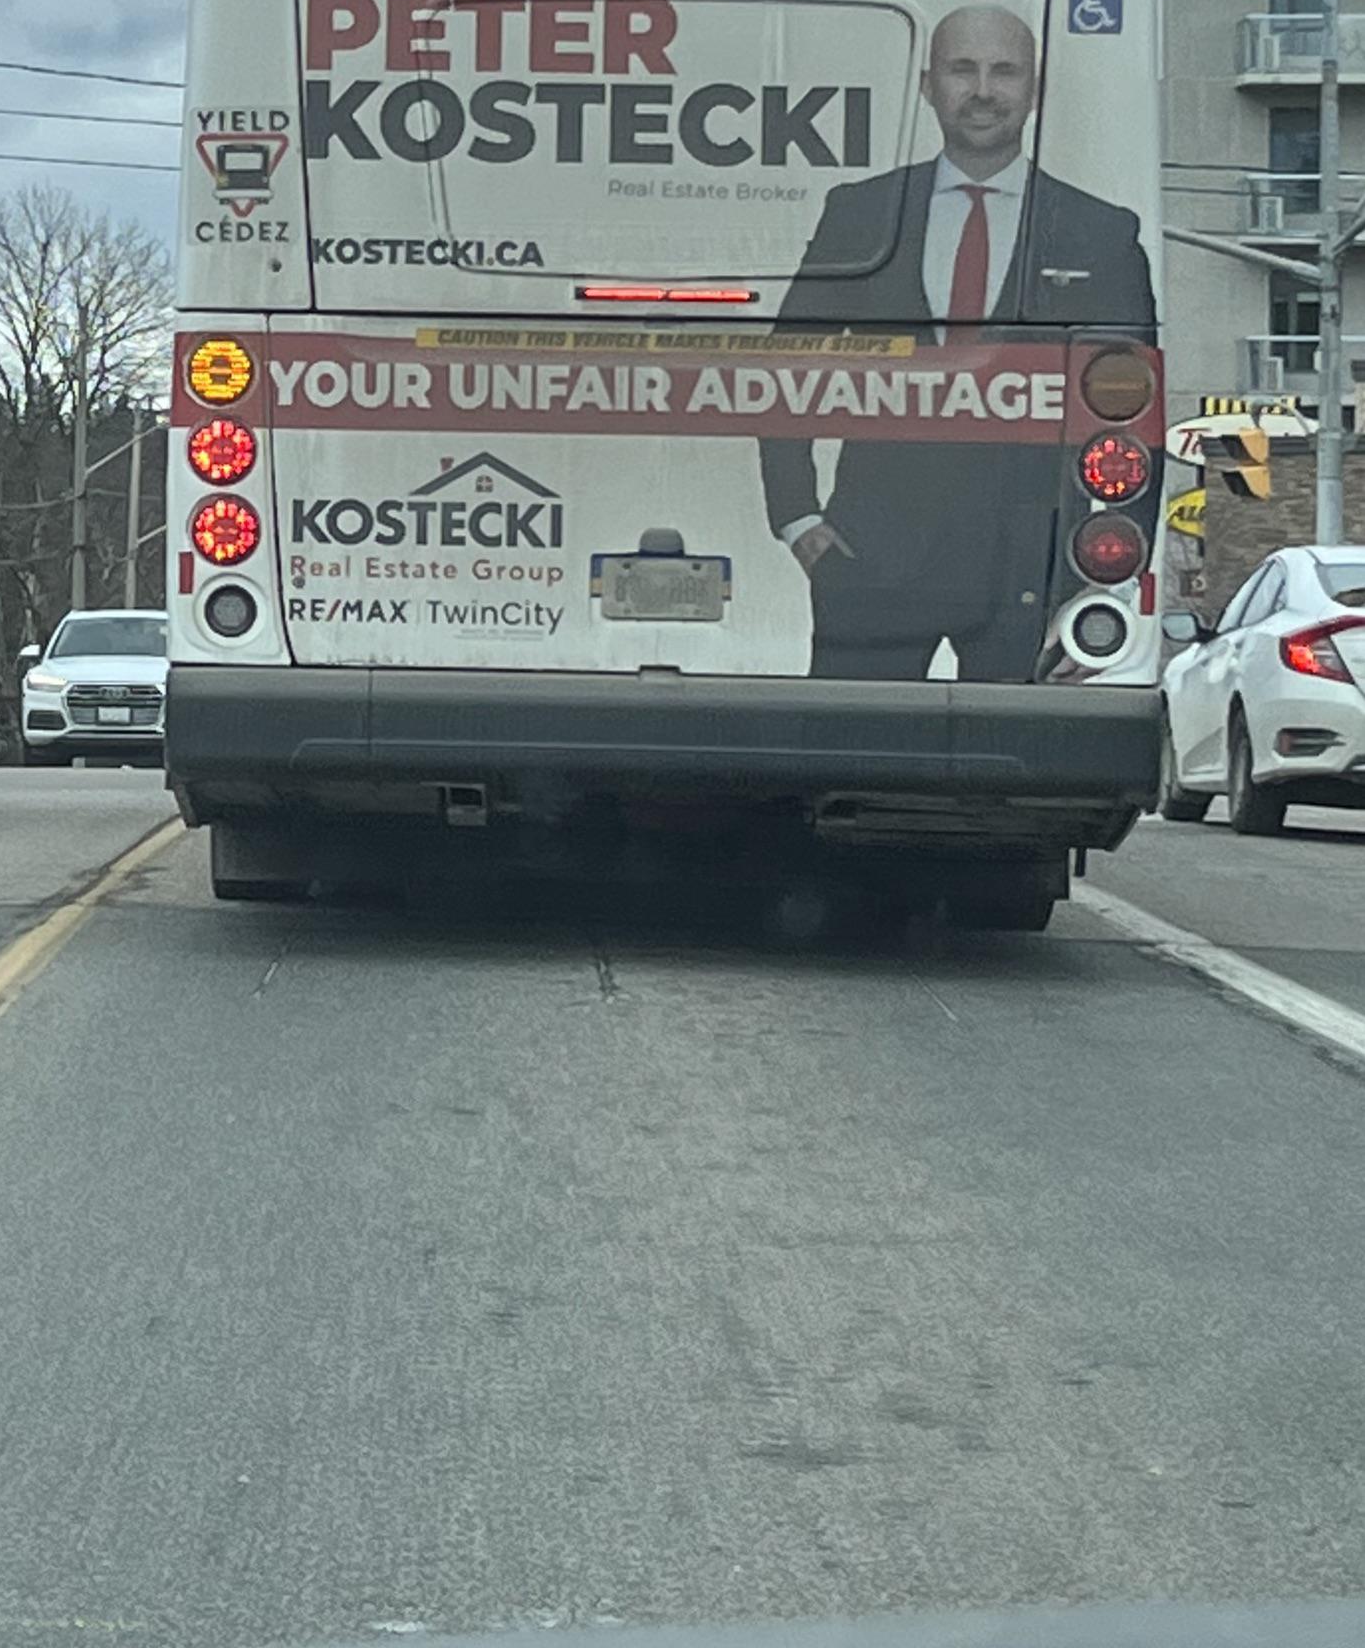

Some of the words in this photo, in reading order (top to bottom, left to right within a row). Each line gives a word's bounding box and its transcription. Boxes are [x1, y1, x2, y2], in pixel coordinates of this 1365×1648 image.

[197, 110, 290, 131] YIELD
[304, 80, 871, 168] KOSTECKI
[608, 179, 654, 197] Real
[661, 181, 729, 199] Estate
[736, 182, 808, 201] Broker
[195, 215, 290, 242] CÉDEZ
[312, 238, 544, 267] KOSTECKI.CA
[439, 329, 519, 346] CAUTION
[527, 330, 566, 347] THIS
[574, 332, 650, 348] VEHICLE
[655, 333, 720, 349] MAKES
[728, 335, 825, 351] FREQUENT
[832, 336, 890, 352] STOPS
[268, 360, 432, 409] YOUR
[449, 363, 673, 412] UNFAIR
[686, 367, 1066, 421] ADVANTAGE
[291, 499, 564, 548] KOSTECKI
[290, 555, 351, 578] Real
[366, 557, 459, 579] Estate
[472, 559, 564, 587] Group
[288, 599, 409, 624] RE/MAX
[425, 600, 565, 635] TwinCity
